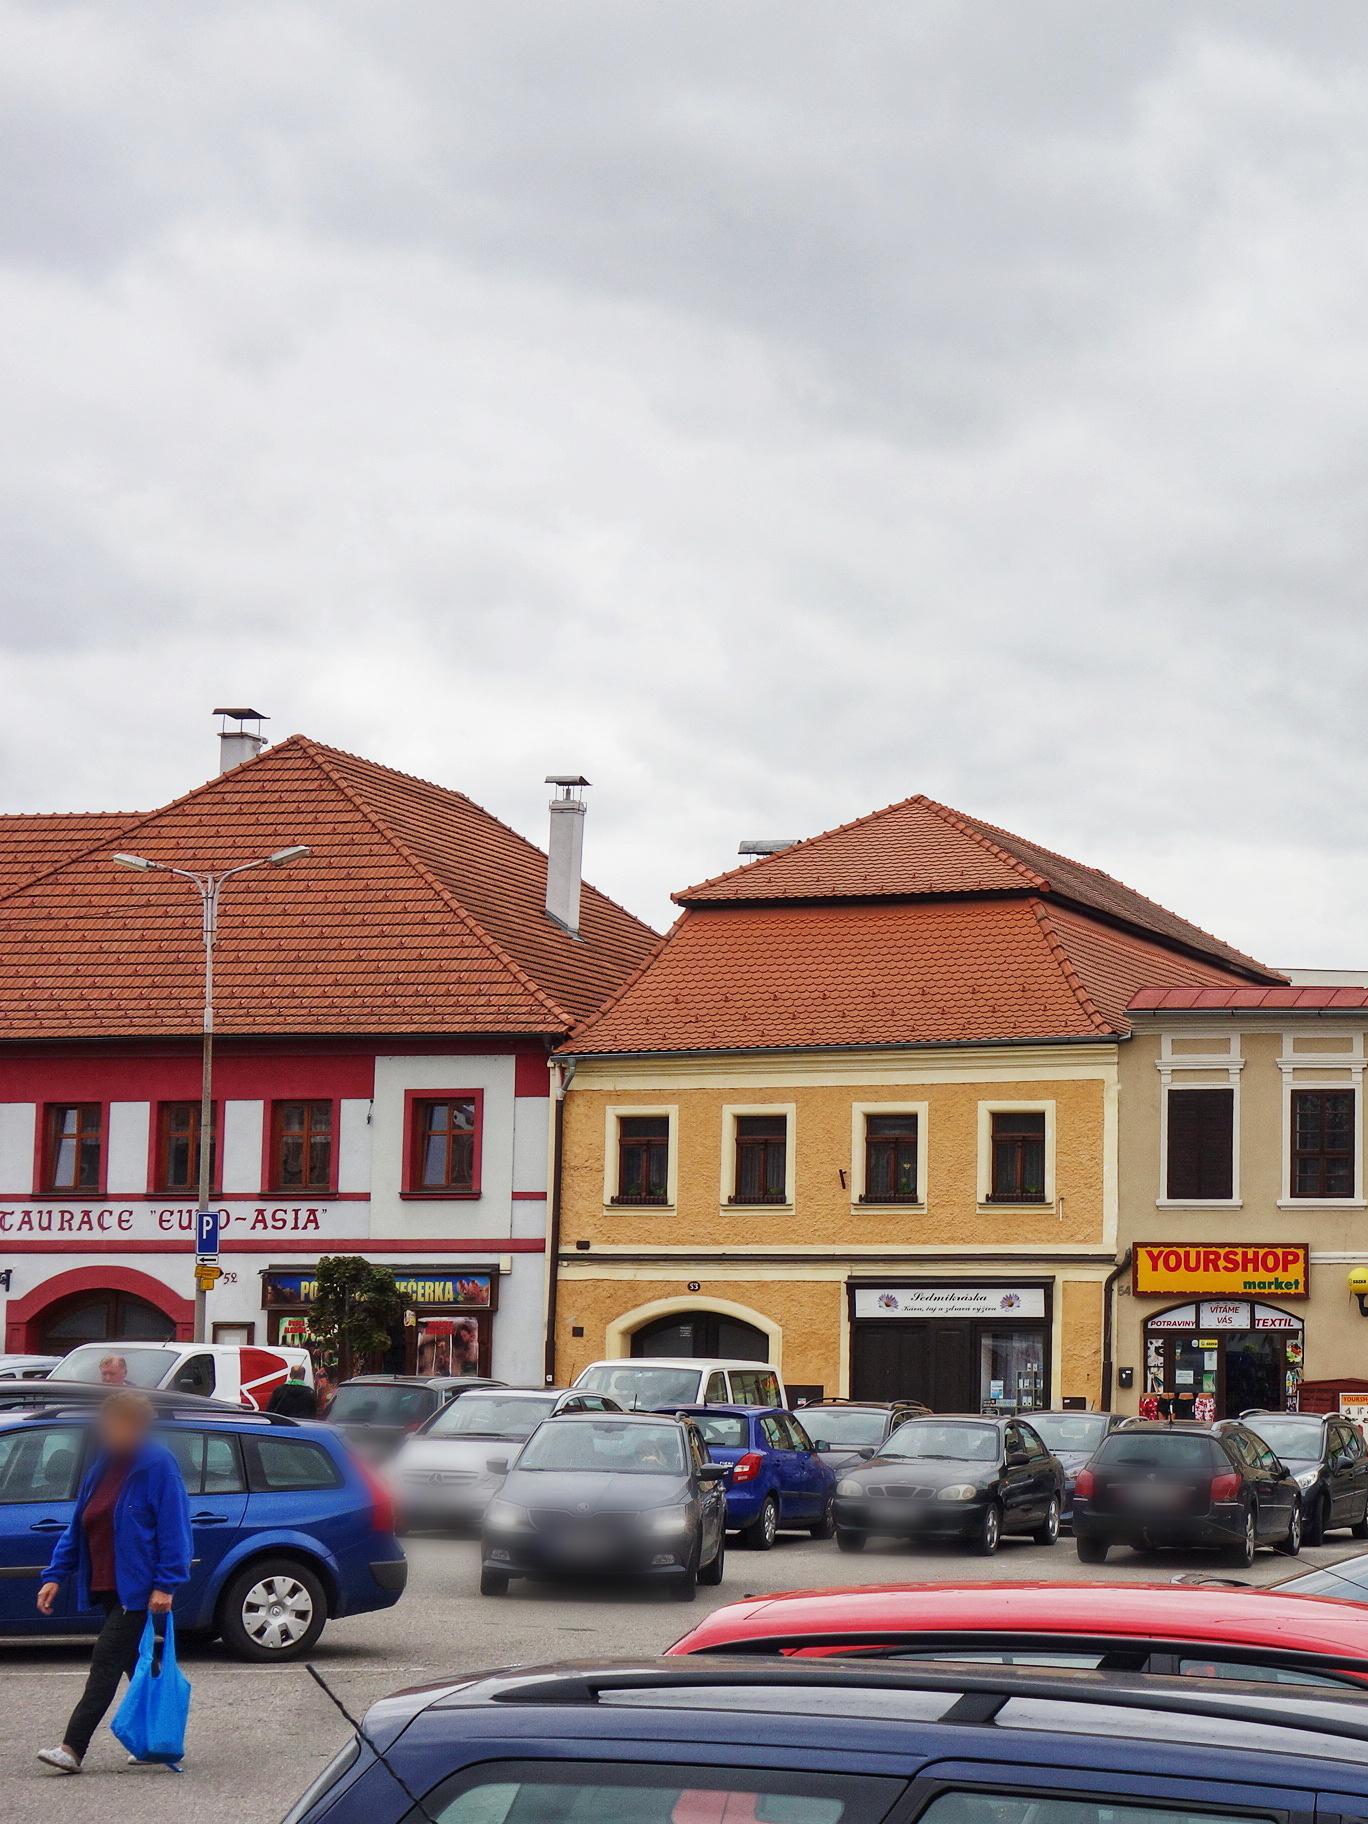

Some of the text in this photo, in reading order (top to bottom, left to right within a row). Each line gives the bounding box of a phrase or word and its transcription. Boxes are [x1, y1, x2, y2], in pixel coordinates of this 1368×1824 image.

[203, 1216, 213, 1239] P
[1145, 1250, 1300, 1273] YOURSHOP
[1243, 1277, 1300, 1291] market
[1150, 1320, 1196, 1328] POTRAVINY
[1216, 1315, 1233, 1325] VÁS
[1255, 1318, 1294, 1328] TEXTIL
